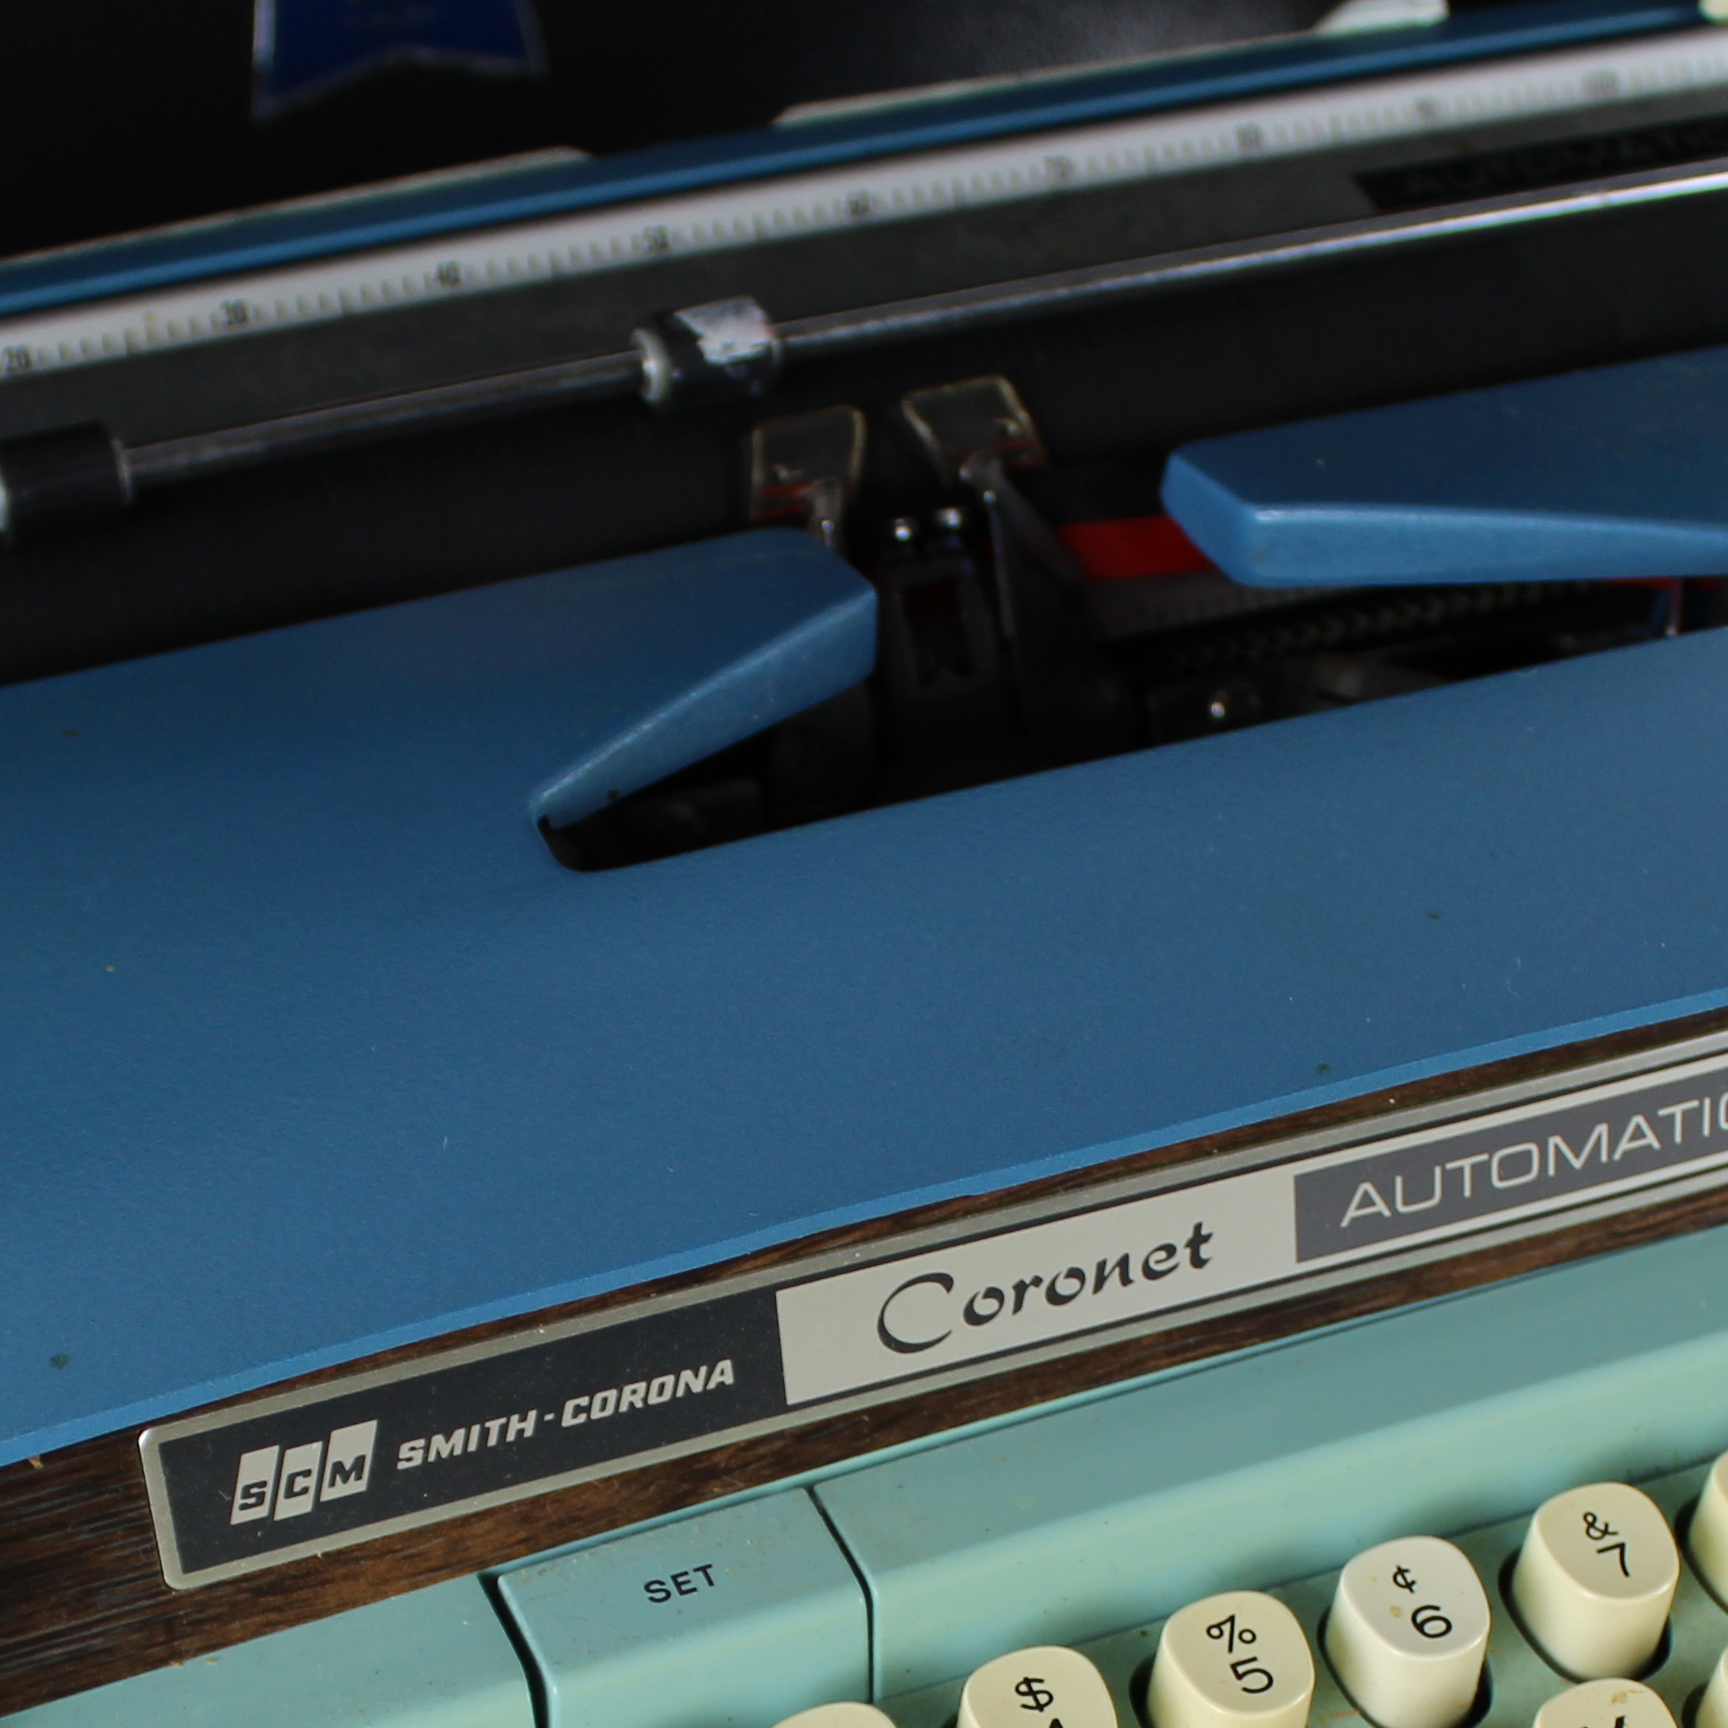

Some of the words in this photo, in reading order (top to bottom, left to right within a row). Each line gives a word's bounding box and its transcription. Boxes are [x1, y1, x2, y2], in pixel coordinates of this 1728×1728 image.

[2, 343, 33, 372] 20
[876, 1219, 1217, 1354] Coronet
[396, 1359, 735, 1471] SMITH-CORONA
[1582, 1511, 1618, 1541] &
[1596, 1542, 1630, 1578] 7
[643, 1563, 715, 1604] SET
[1206, 1614, 1257, 1654] %
[1410, 1604, 1453, 1639] 6
[1229, 1656, 1274, 1694] 5
[1014, 1676, 1054, 1713] $
